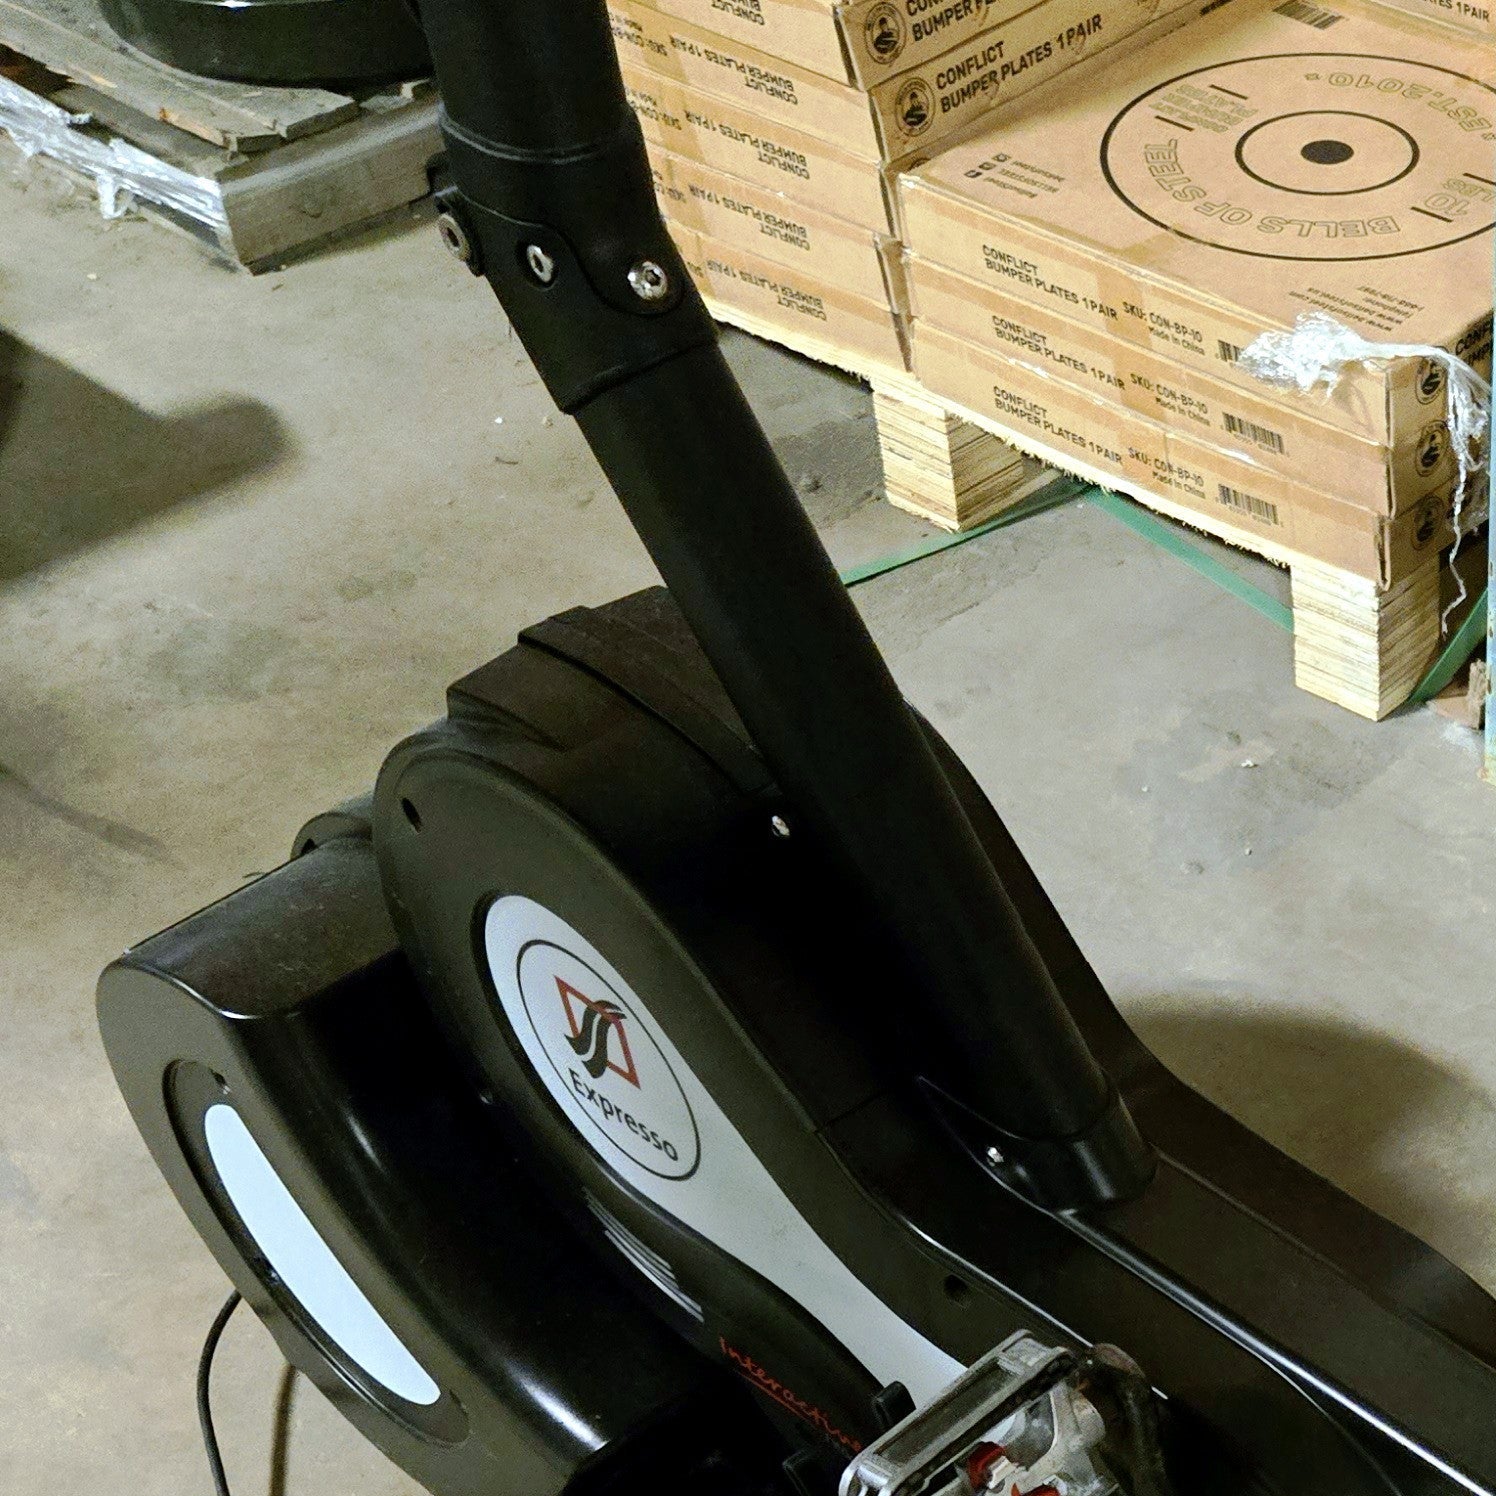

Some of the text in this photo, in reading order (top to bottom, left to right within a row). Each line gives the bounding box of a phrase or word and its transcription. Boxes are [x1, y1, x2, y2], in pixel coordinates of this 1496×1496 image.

[711, 3, 766, 26] CONFLICT
[911, 1, 973, 41] BUMPER
[1463, 4, 1490, 22] PAIR
[705, 49, 746, 74] PLATES
[935, 40, 1005, 90] CONFLICT
[940, 69, 999, 113] BUMPER
[1000, 41, 1053, 81] PLATES
[1066, 14, 1102, 46] PAIR
[745, 76, 798, 105] CONFLICT
[749, 65, 794, 92] BUMPER
[719, 123, 761, 148] PLATES
[758, 151, 810, 180] CONFLICT
[761, 141, 807, 167] BUMPER
[1144, 139, 1400, 238] BELLS OF STEEL
[722, 196, 762, 220] PLATES
[1424, 192, 1470, 217] 10
[760, 223, 811, 251] CONFLICT
[763, 213, 807, 238] BUMPER
[982, 244, 1038, 276] CONFLICT
[985, 257, 1033, 288] BUMPER
[1035, 280, 1080, 304] PLATES
[1090, 300, 1118, 321] PAIR
[778, 295, 827, 321] CONFLICT
[1122, 301, 1147, 322] SKU:
[992, 315, 1047, 345] CONFLICT
[994, 327, 1042, 357] BUMPER
[1044, 347, 1087, 374] PLATES
[1098, 370, 1125, 391] PAIR
[1130, 373, 1155, 391] SKU:
[993, 385, 1048, 418] CONFLICT
[995, 397, 1042, 427] BUMPER
[1043, 421, 1087, 448] PLATES
[1096, 444, 1123, 465] PAIR
[1128, 447, 1152, 466] SKU:
[568, 1067, 679, 1162] Expresso
